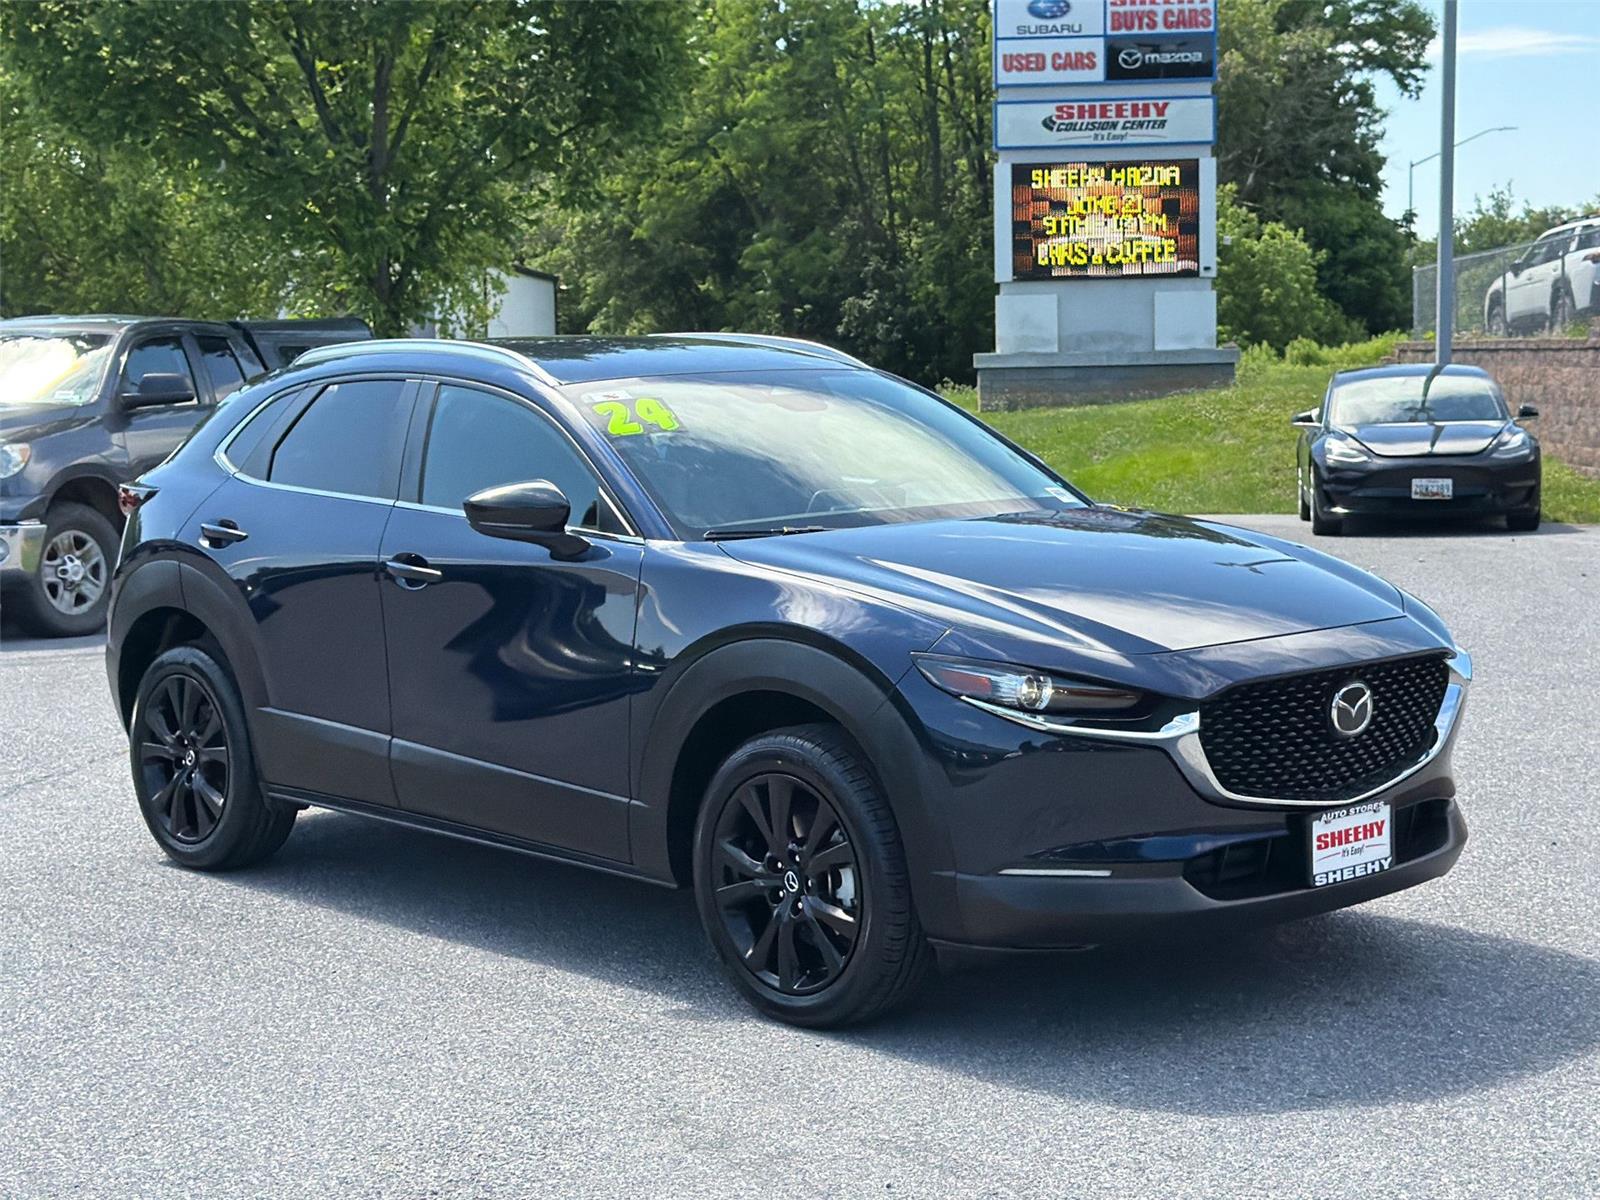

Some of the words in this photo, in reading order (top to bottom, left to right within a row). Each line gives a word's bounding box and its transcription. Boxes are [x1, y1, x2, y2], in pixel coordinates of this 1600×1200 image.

[1016, 24, 1082, 35] SUBARU
[1110, 10, 1158, 31] BUYS
[1163, 8, 1212, 29] CARS
[1002, 53, 1046, 73] USED
[1051, 51, 1097, 71] CARS
[1145, 51, 1202, 64] mazda
[1055, 102, 1169, 120] SHEEHY
[1056, 120, 1119, 132] COLLISION
[1121, 119, 1168, 130] CENTER
[592, 398, 680, 436] 24
[1321, 809, 1347, 821] AUTO
[1349, 801, 1385, 815] STORES
[1316, 819, 1386, 851] SHEEHY
[1314, 857, 1392, 887] SHEEHY
